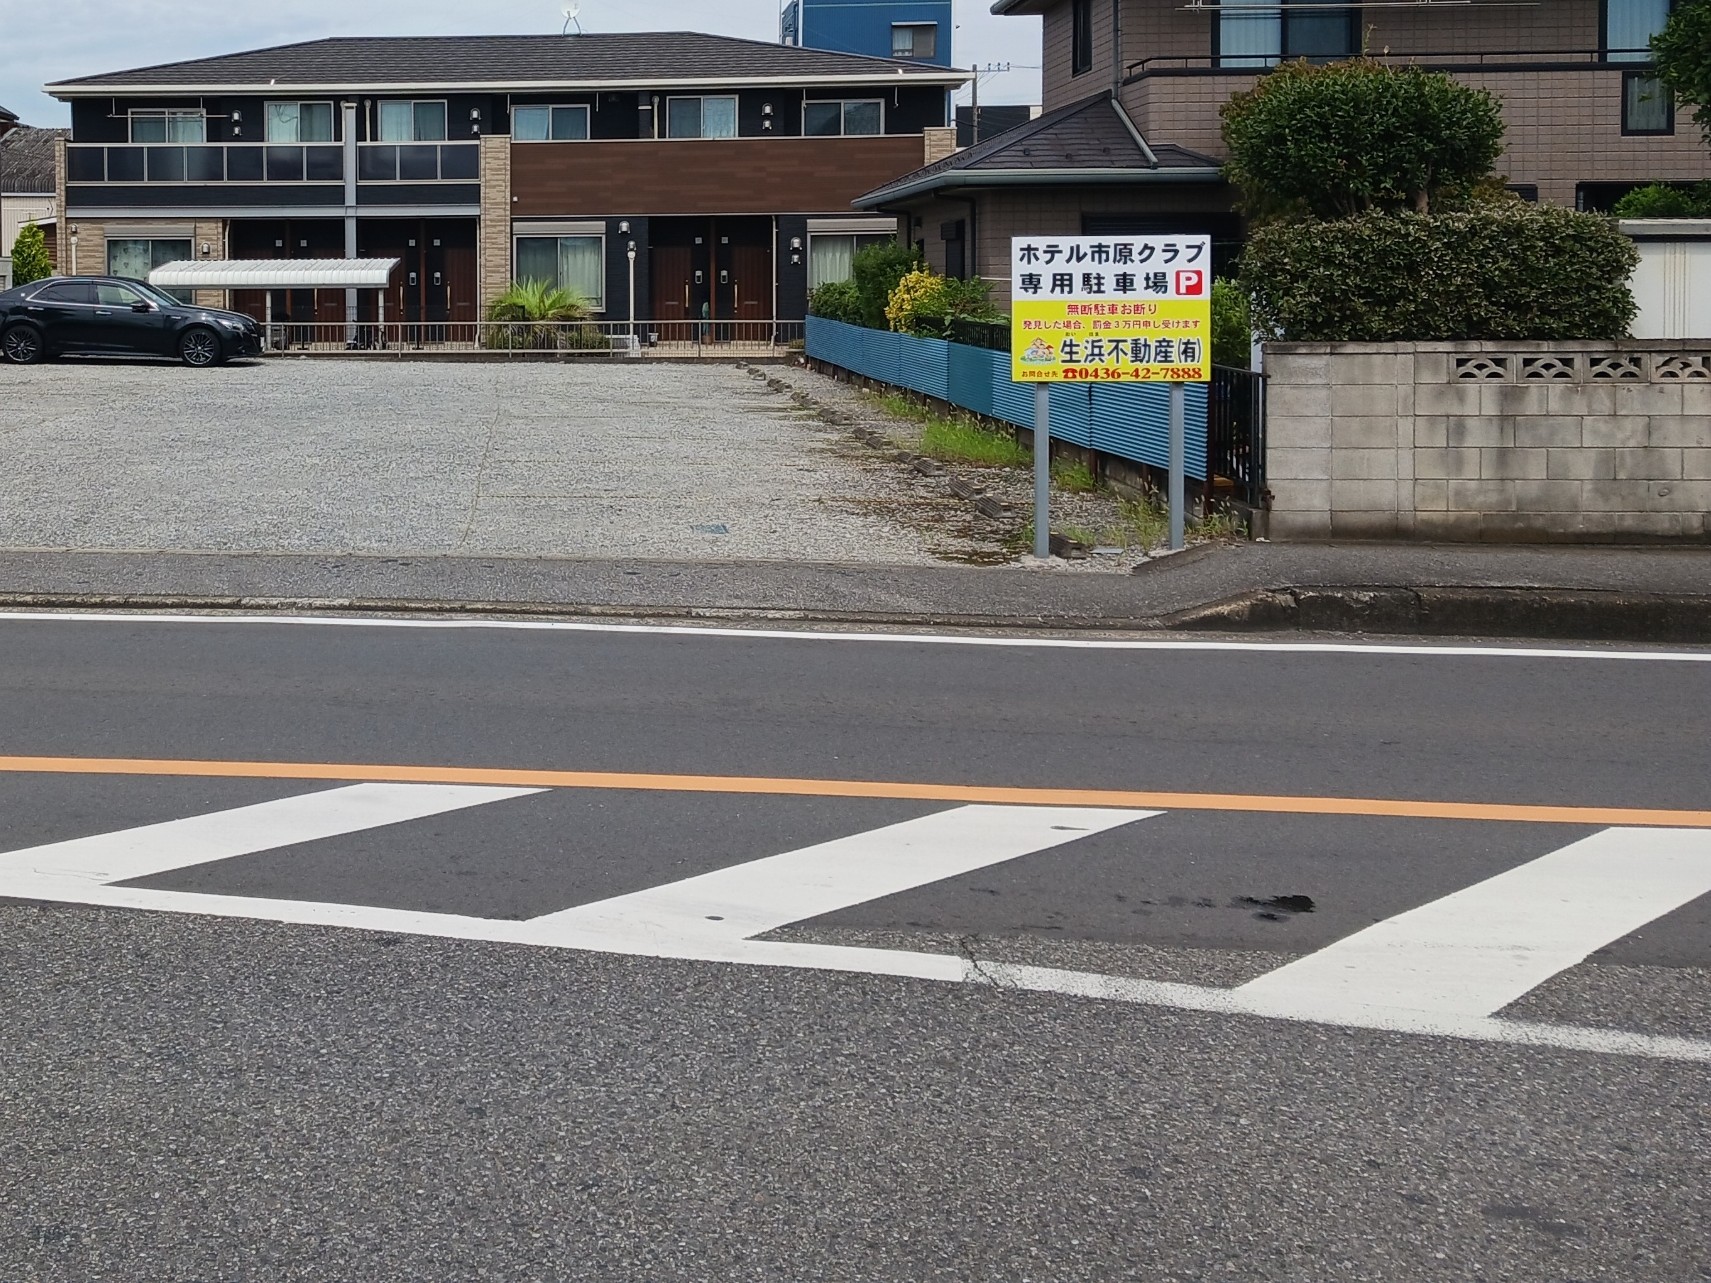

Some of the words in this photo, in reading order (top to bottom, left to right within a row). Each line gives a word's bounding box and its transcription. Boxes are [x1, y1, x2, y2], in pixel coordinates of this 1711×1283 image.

[1019, 241, 1206, 265] ホテル市原クラブ
[1019, 272, 1169, 294] 専用駐車場
[1179, 271, 1199, 294] P
[1067, 303, 1157, 315] 無断駐車お断り
[1021, 370, 1059, 378] お問合せ先
[1079, 367, 1203, 379] 0436-42-7888
